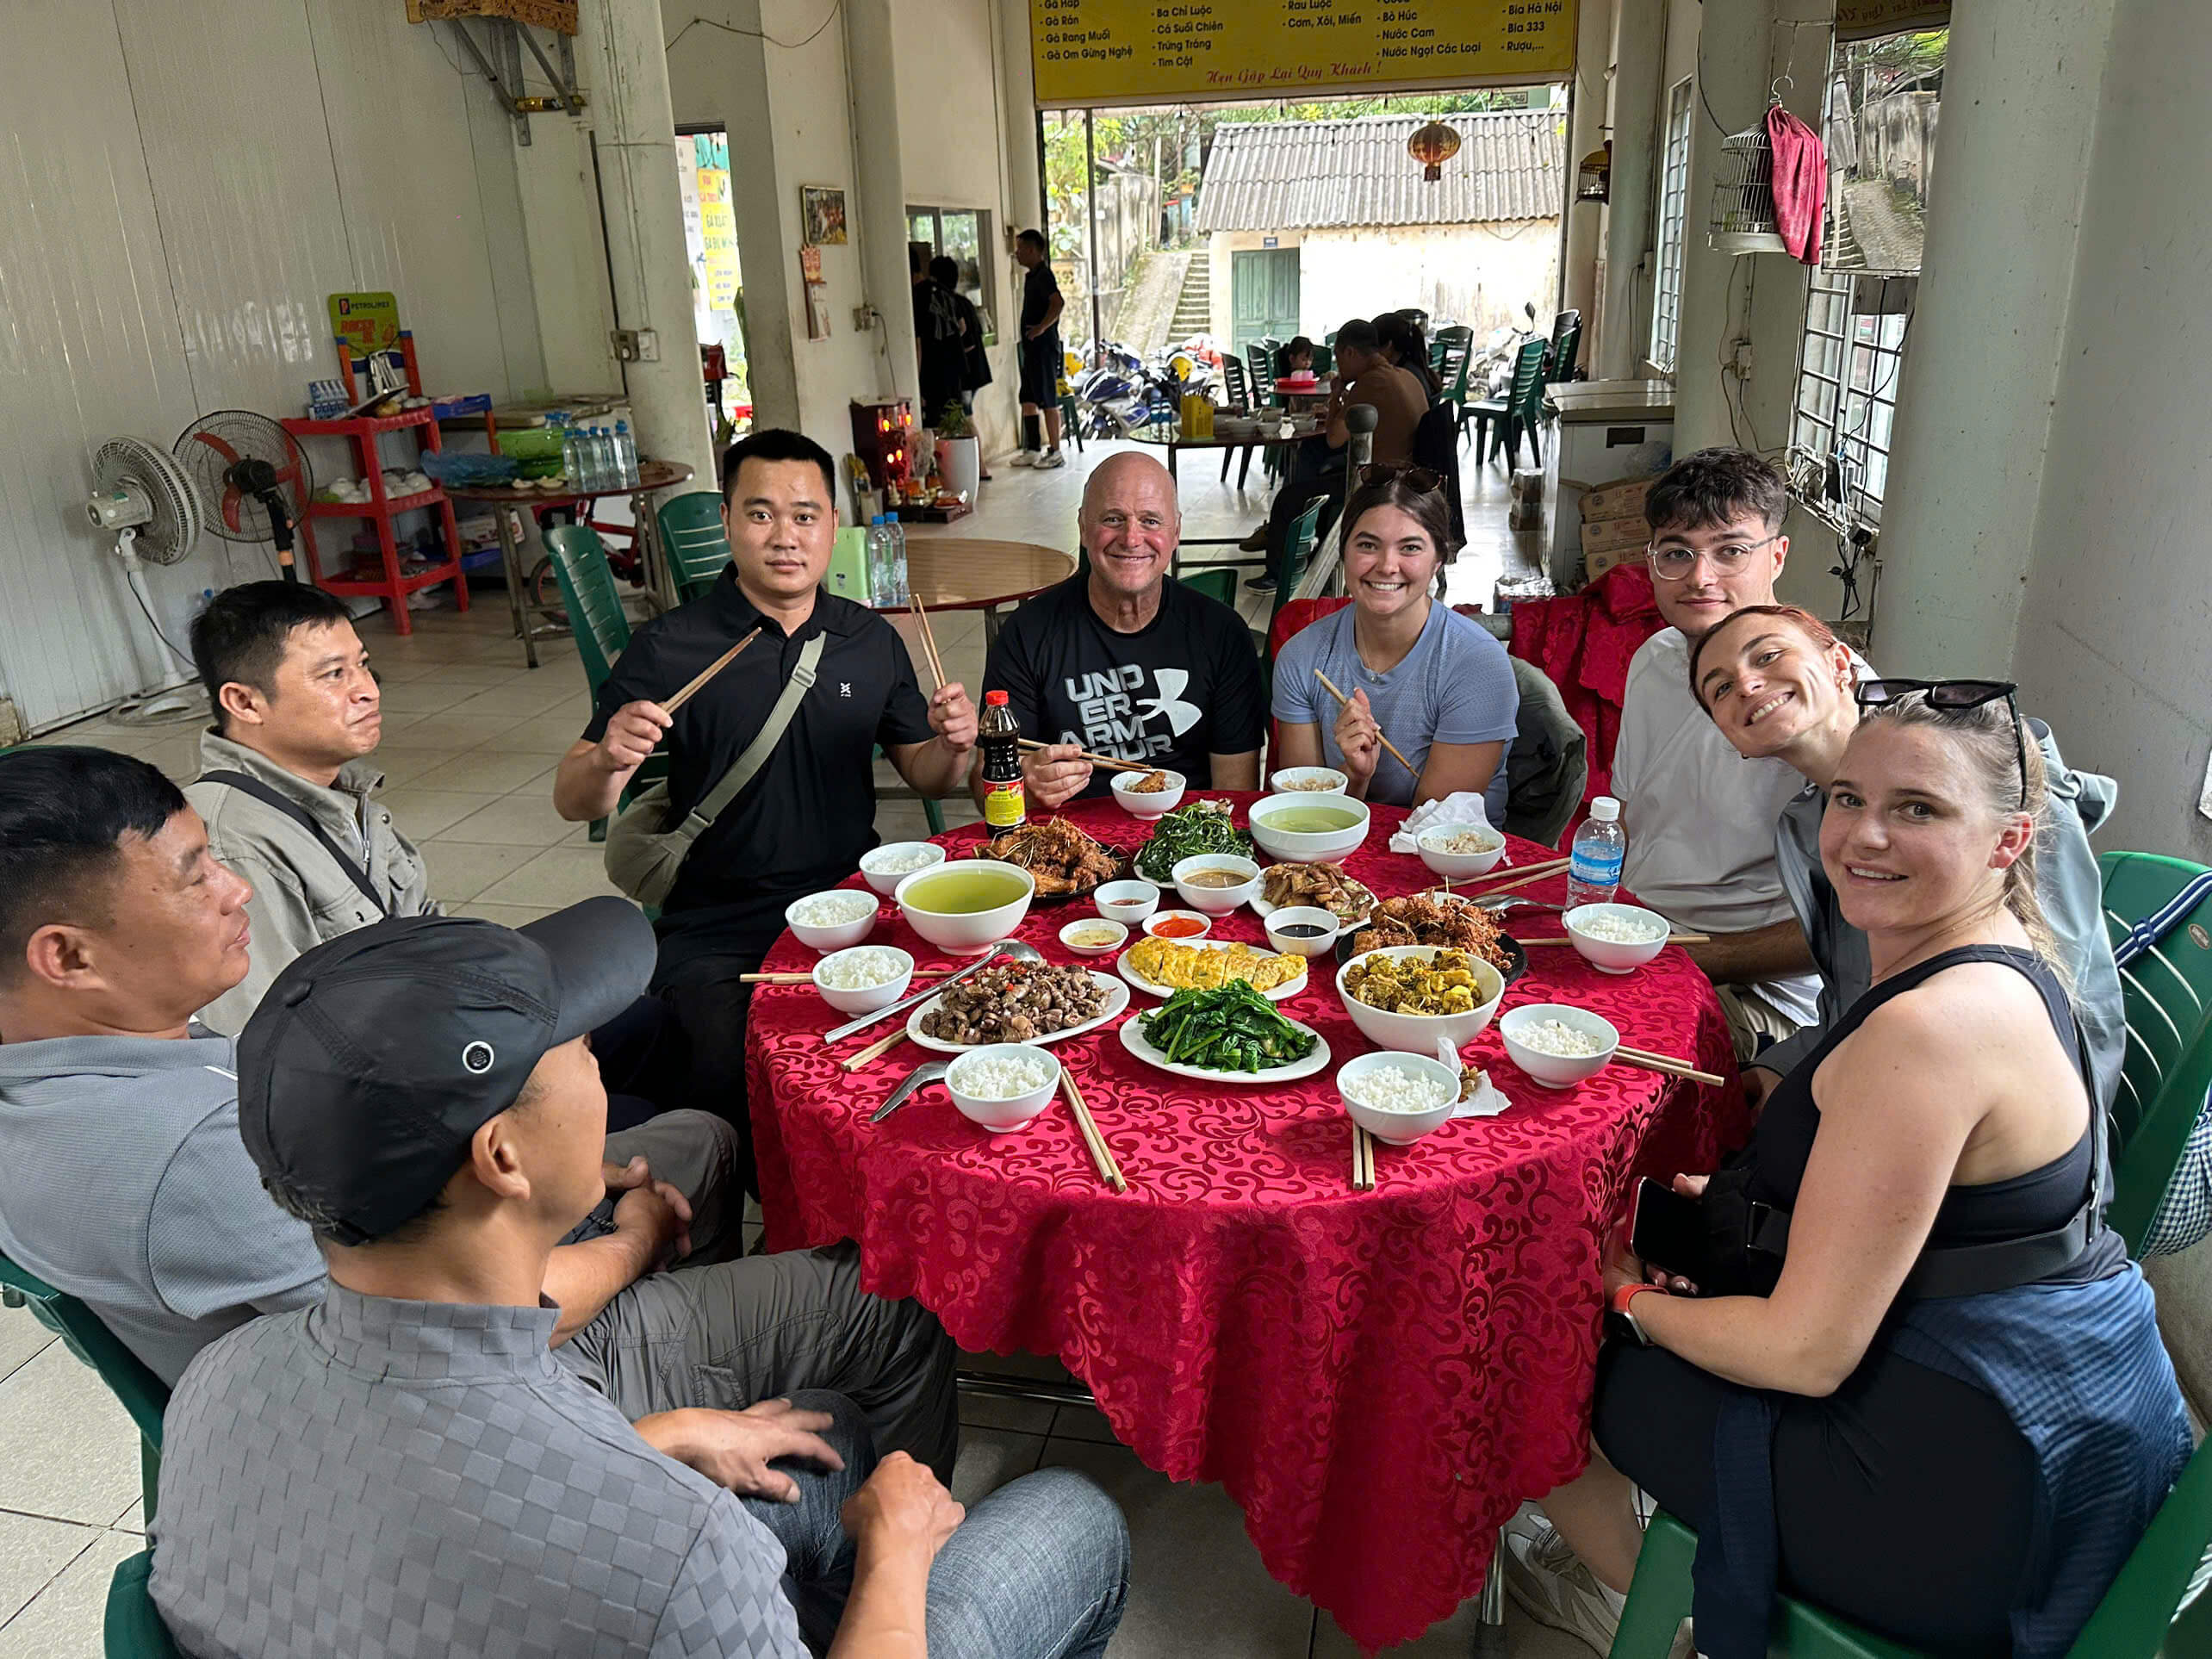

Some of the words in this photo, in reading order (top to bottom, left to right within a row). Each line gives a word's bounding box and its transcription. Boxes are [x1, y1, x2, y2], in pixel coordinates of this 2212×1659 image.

[1288, 0, 1307, 10] Rau
[1508, 4, 1525, 15] Bia
[1527, 2, 1542, 14] Hà
[1157, 8, 1170, 17] Ba
[1382, 10, 1395, 22] Bò
[1398, 9, 1418, 21] Húc
[1045, 16, 1059, 26] Gà
[1061, 14, 1080, 25] Rán
[1157, 22, 1171, 34] Cá
[1507, 22, 1524, 33] Bia
[1526, 21, 1544, 32] 333
[1045, 33, 1060, 43] Gà
[1062, 32, 1086, 44] Rang
[1410, 28, 1435, 39] Cam
[1047, 49, 1061, 60] Gà
[1063, 49, 1079, 59] Om
[1436, 43, 1457, 54] Các
[1157, 57, 1174, 67] Tim
[1065, 663, 1145, 703] UND
[1078, 693, 1134, 725] ER
[1059, 715, 1146, 750] ARM
